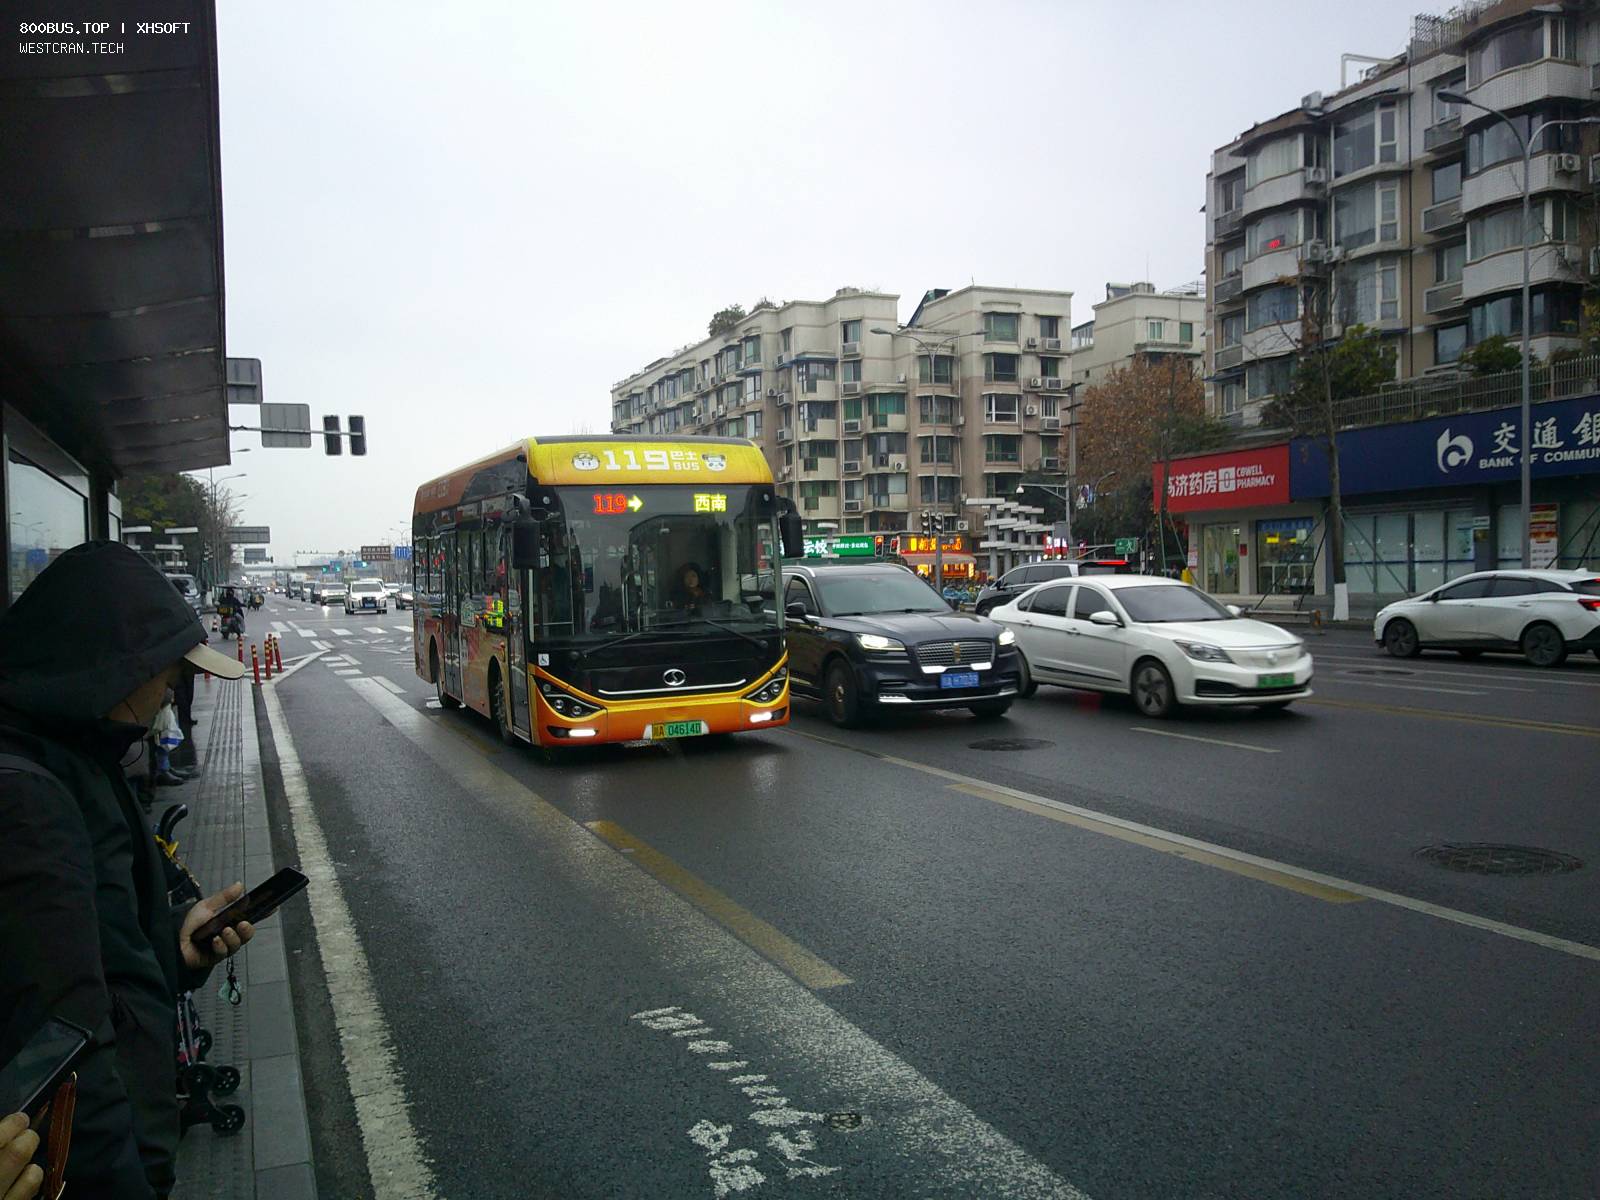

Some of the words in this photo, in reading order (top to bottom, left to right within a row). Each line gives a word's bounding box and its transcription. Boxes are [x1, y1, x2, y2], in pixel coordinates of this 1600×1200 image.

[603, 449, 670, 470] 119
[670, 450, 698, 461] 巴士
[673, 461, 700, 471] BUS
[1479, 456, 1514, 469] BANK
[1520, 453, 1538, 464] F
[1236, 474, 1275, 489] PHARMACY
[593, 493, 627, 514] 119
[693, 493, 727, 513] 西南
